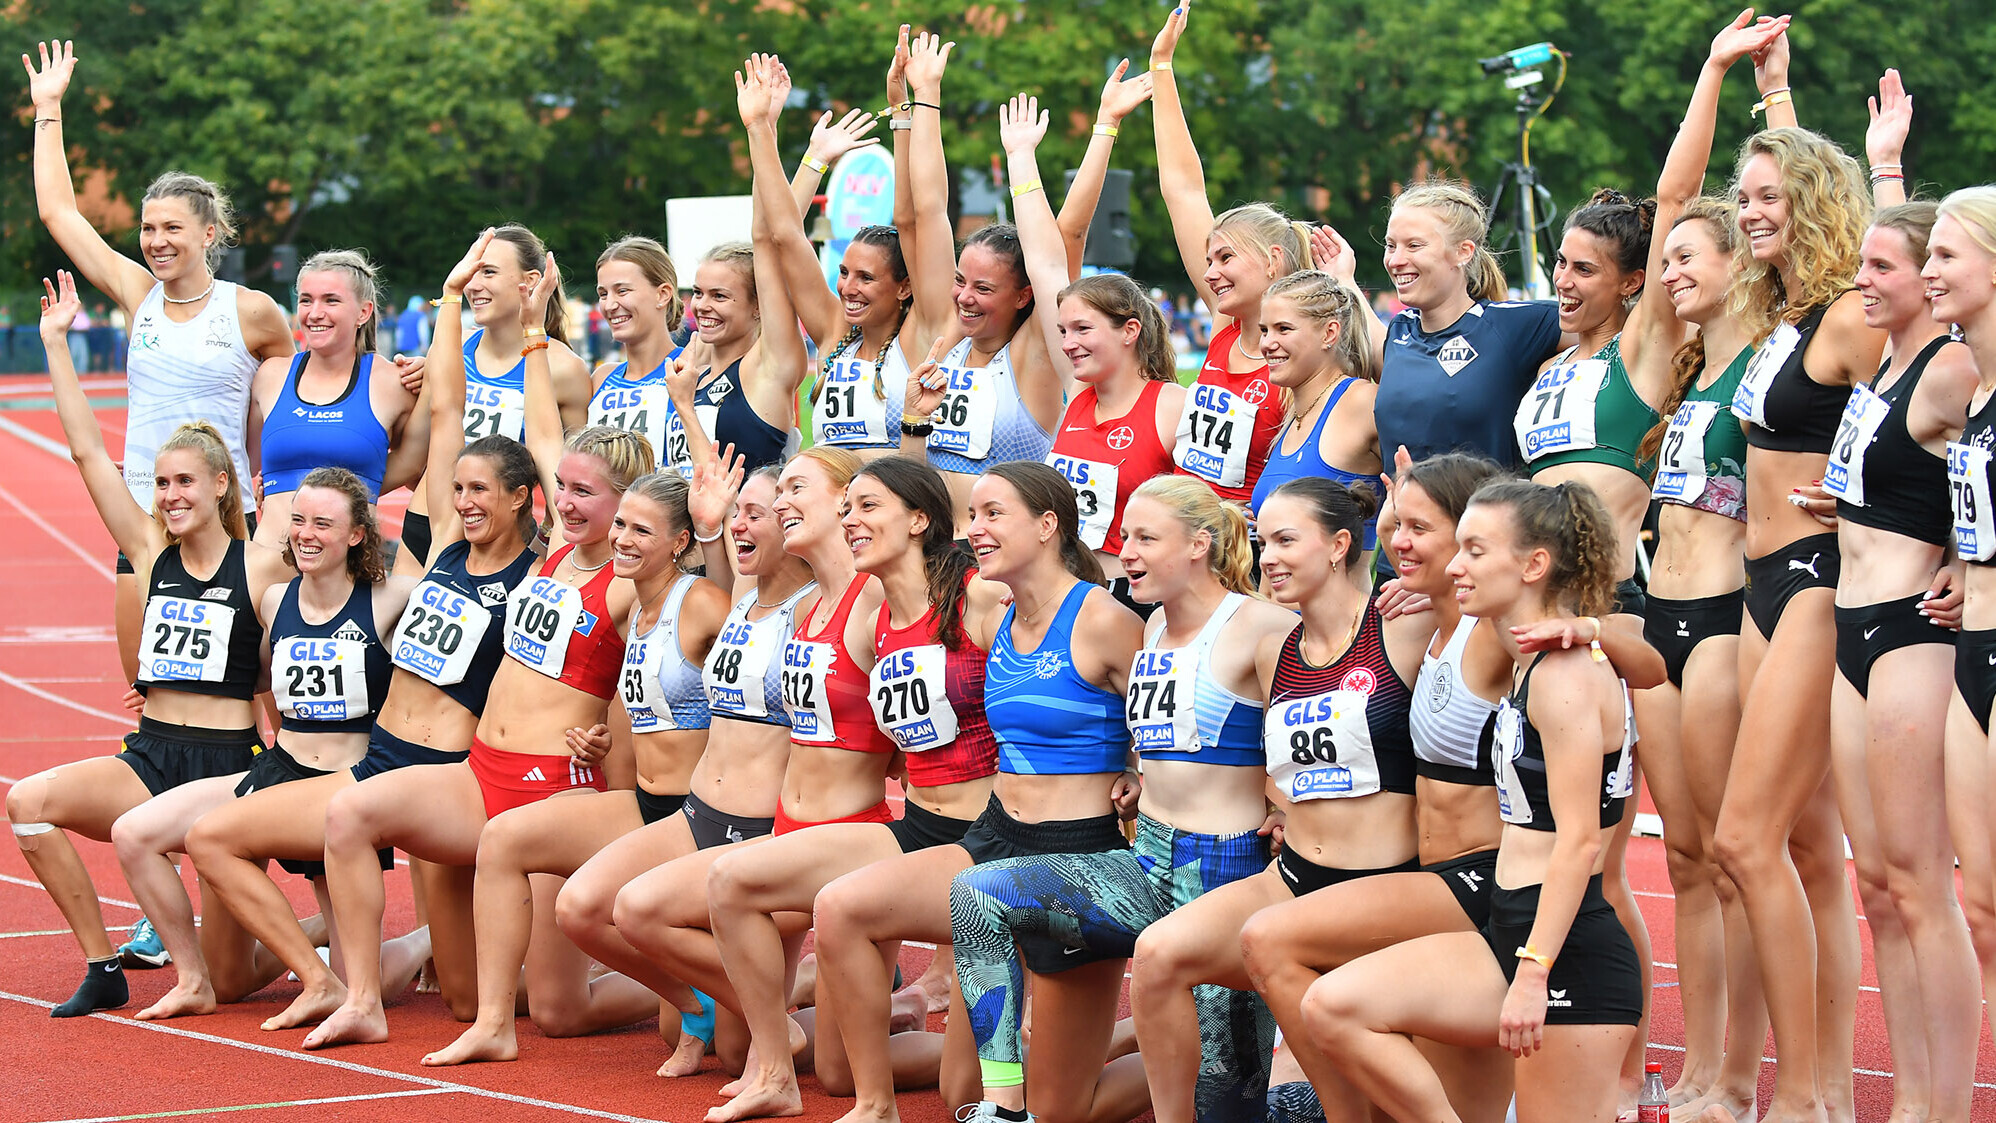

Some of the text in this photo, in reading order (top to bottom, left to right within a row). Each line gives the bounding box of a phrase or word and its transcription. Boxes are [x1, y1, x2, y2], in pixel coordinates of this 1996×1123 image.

[1441, 348, 1469, 361] MTV
[308, 411, 343, 419] LACOS
[825, 386, 855, 418] 51
[1532, 387, 1566, 426] 71
[942, 434, 968, 444] PLAN
[1190, 410, 1234, 454] 174
[1540, 426, 1568, 442] PLAN
[1832, 419, 1859, 464] 78
[1664, 430, 1684, 468] 72
[1198, 455, 1222, 472] PLAN
[482, 588, 505, 602] MTV
[404, 606, 463, 656] 230
[514, 596, 560, 642] 109
[153, 623, 212, 660] 275
[338, 632, 360, 640] MTV
[522, 640, 544, 659] PLAN
[170, 664, 200, 677] PLAN
[413, 649, 444, 671] PLAN
[712, 648, 742, 684] 48
[286, 664, 344, 697] 231
[625, 669, 644, 704] 53
[782, 670, 816, 709] 312
[314, 704, 344, 714] PLAN
[718, 692, 742, 703] PLAN
[878, 678, 930, 724] 270
[1128, 680, 1176, 722] 274
[906, 724, 934, 740] PLAN
[1143, 728, 1172, 740] PLAN
[1290, 727, 1337, 766] 86
[1314, 770, 1351, 785] PLAN
